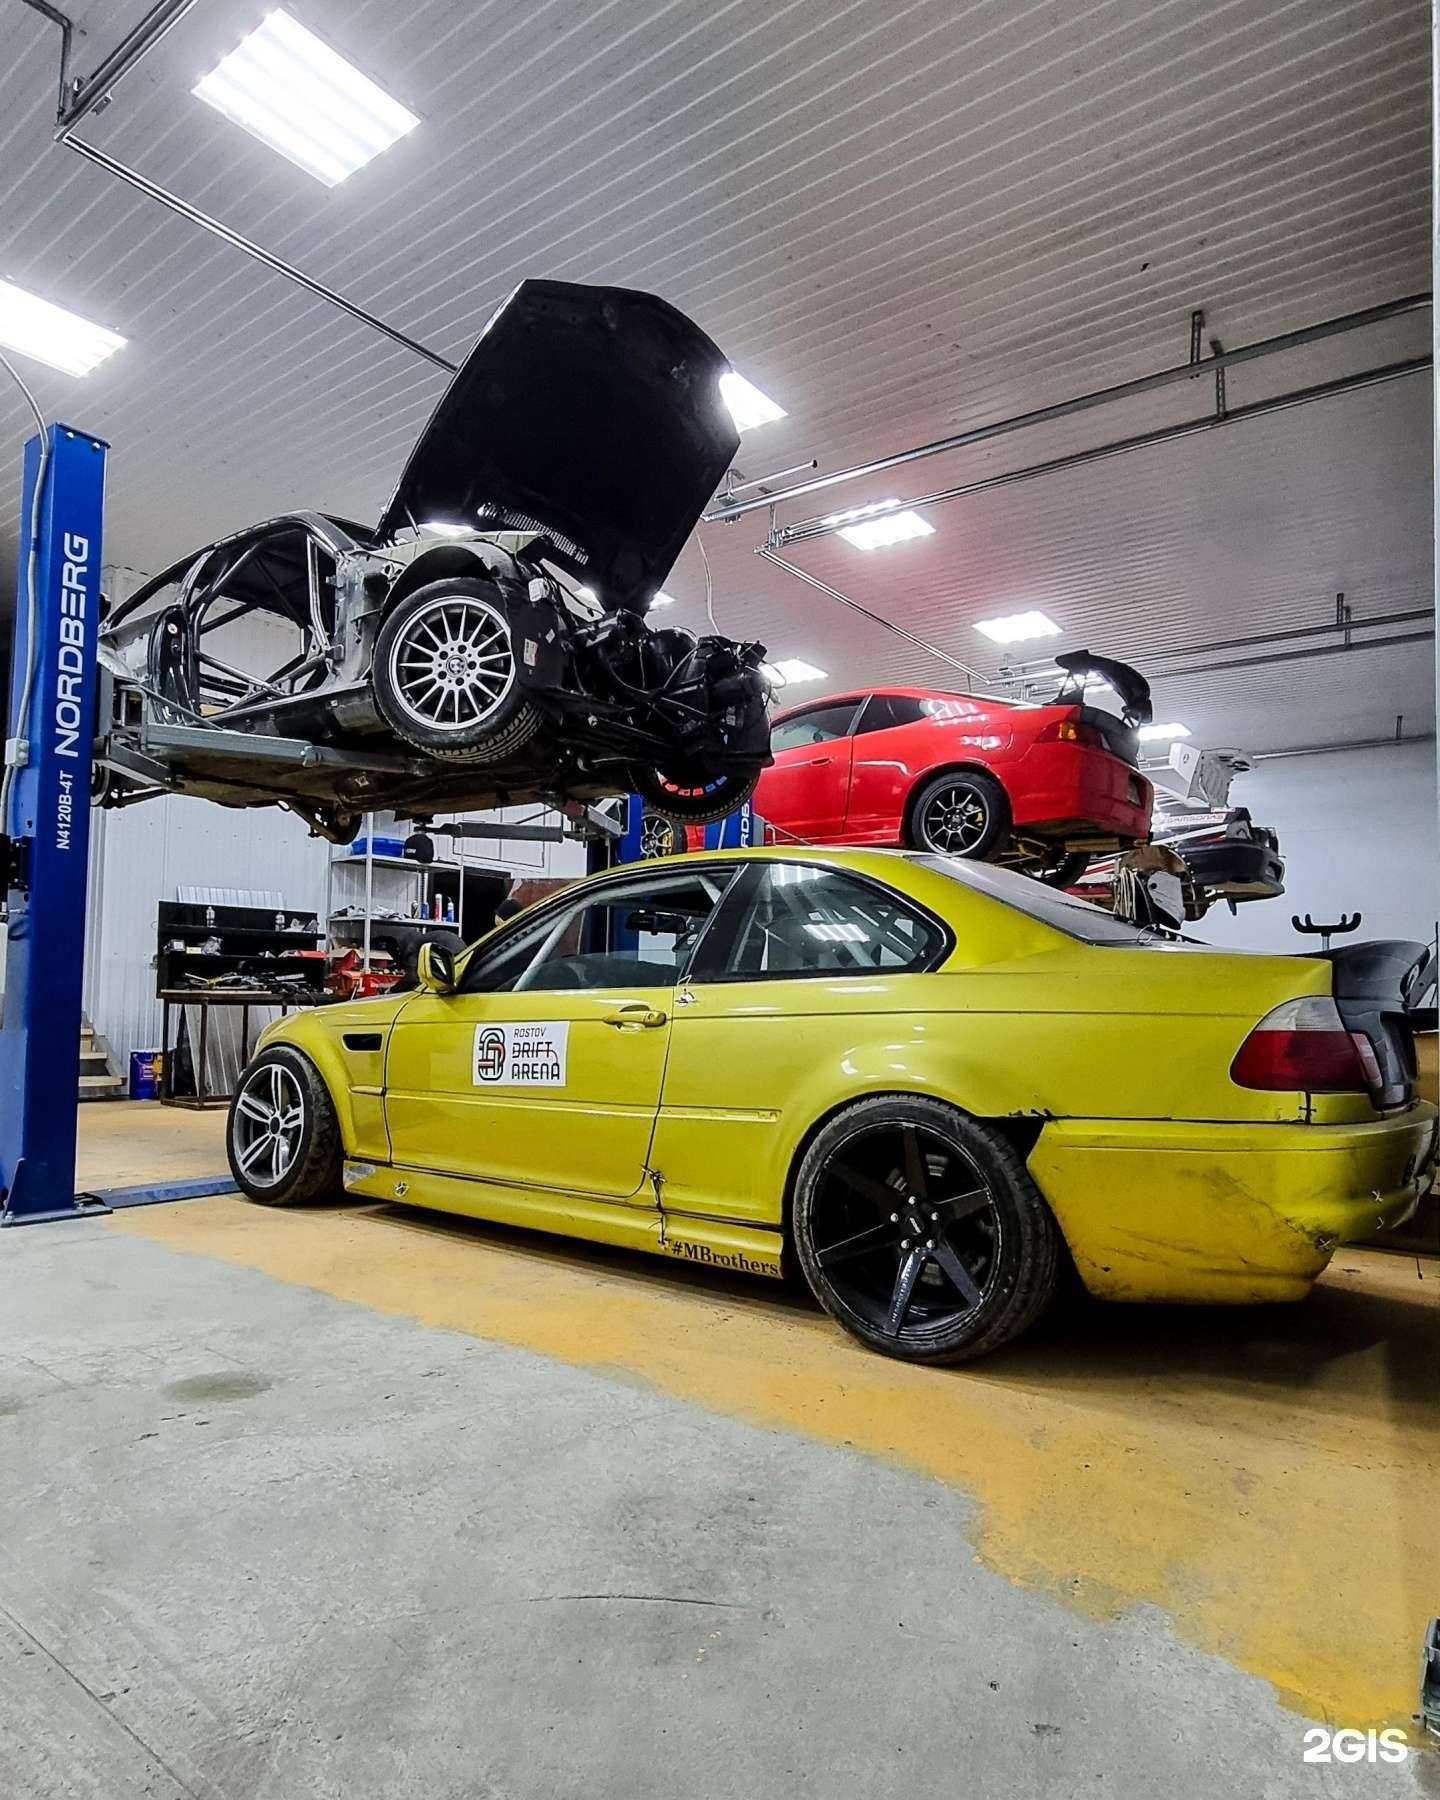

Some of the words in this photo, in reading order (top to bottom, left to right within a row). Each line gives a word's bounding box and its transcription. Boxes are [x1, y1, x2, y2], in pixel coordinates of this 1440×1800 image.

[54, 532, 88, 757] NORDBERG
[56, 769, 74, 849] N4120B-4T
[513, 1027, 547, 1038] ROSTOV
[512, 1042, 553, 1058] DRIFT
[511, 1063, 561, 1080] ARENA
[671, 1241, 779, 1275] #MBrothers
